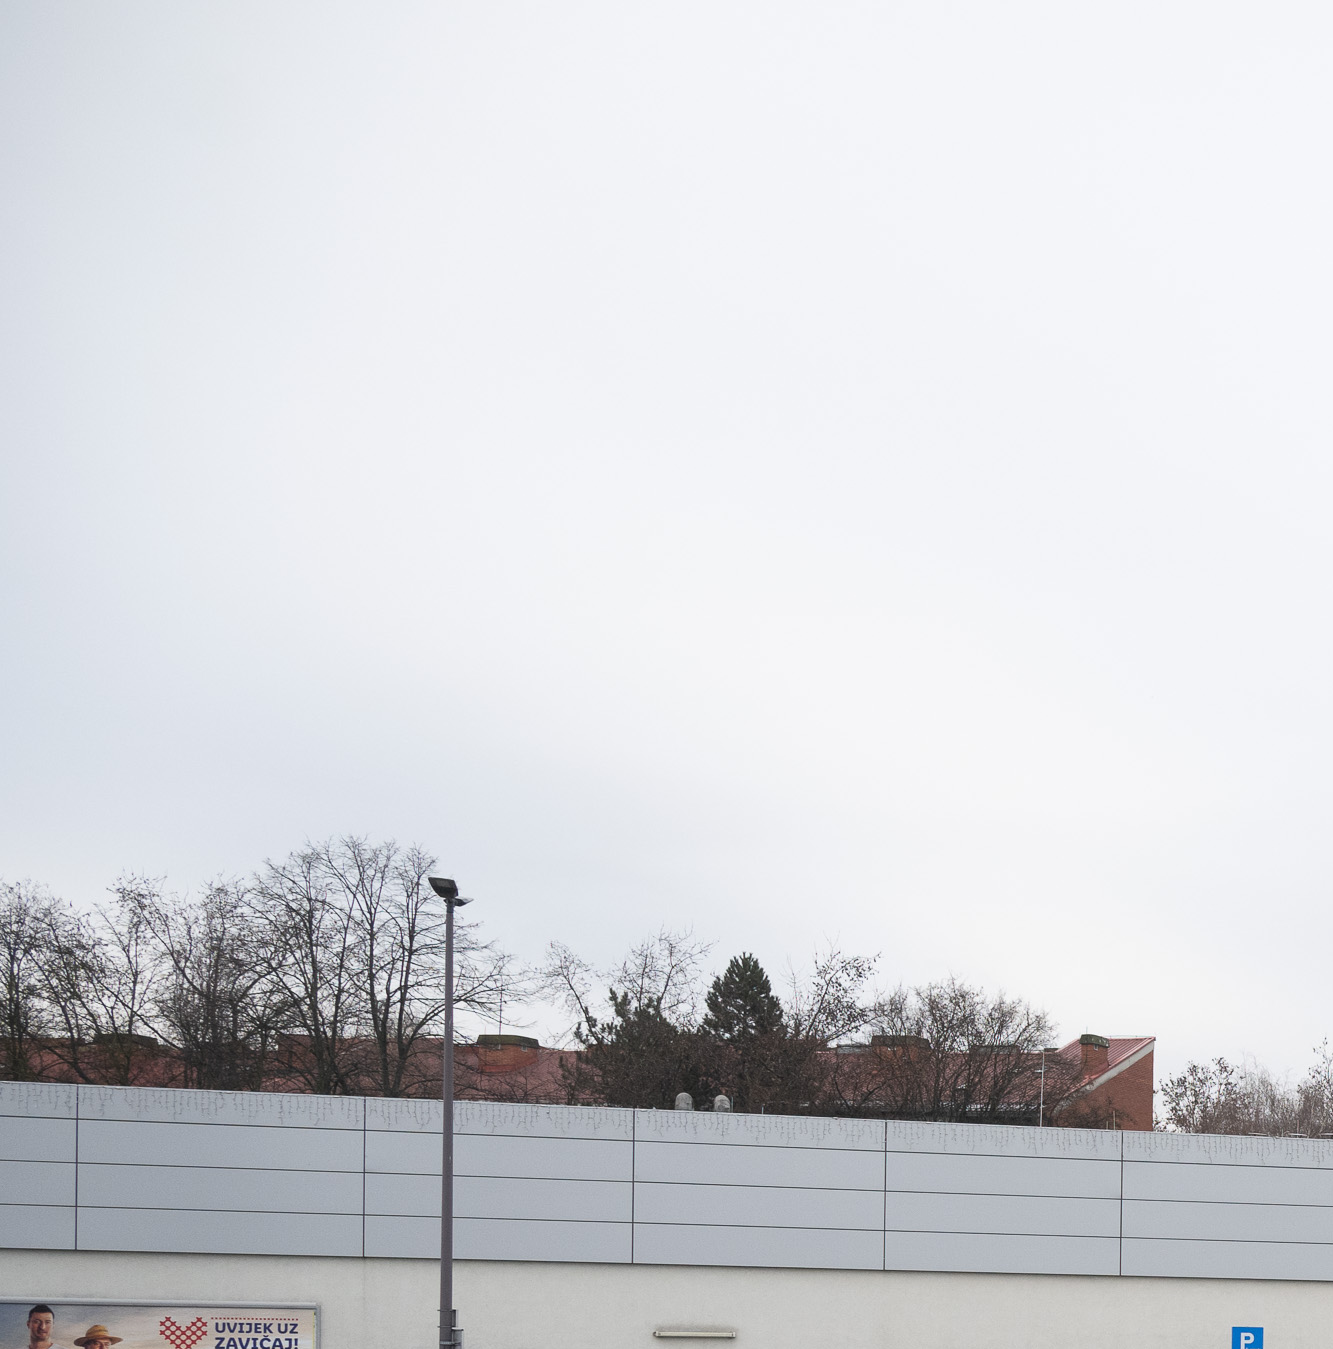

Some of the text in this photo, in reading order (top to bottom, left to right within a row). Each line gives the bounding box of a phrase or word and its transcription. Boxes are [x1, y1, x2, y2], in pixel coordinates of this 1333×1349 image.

[215, 1322, 299, 1334] UVIJEK UZ
[214, 1335, 299, 1349] ZAVIČAJ!
